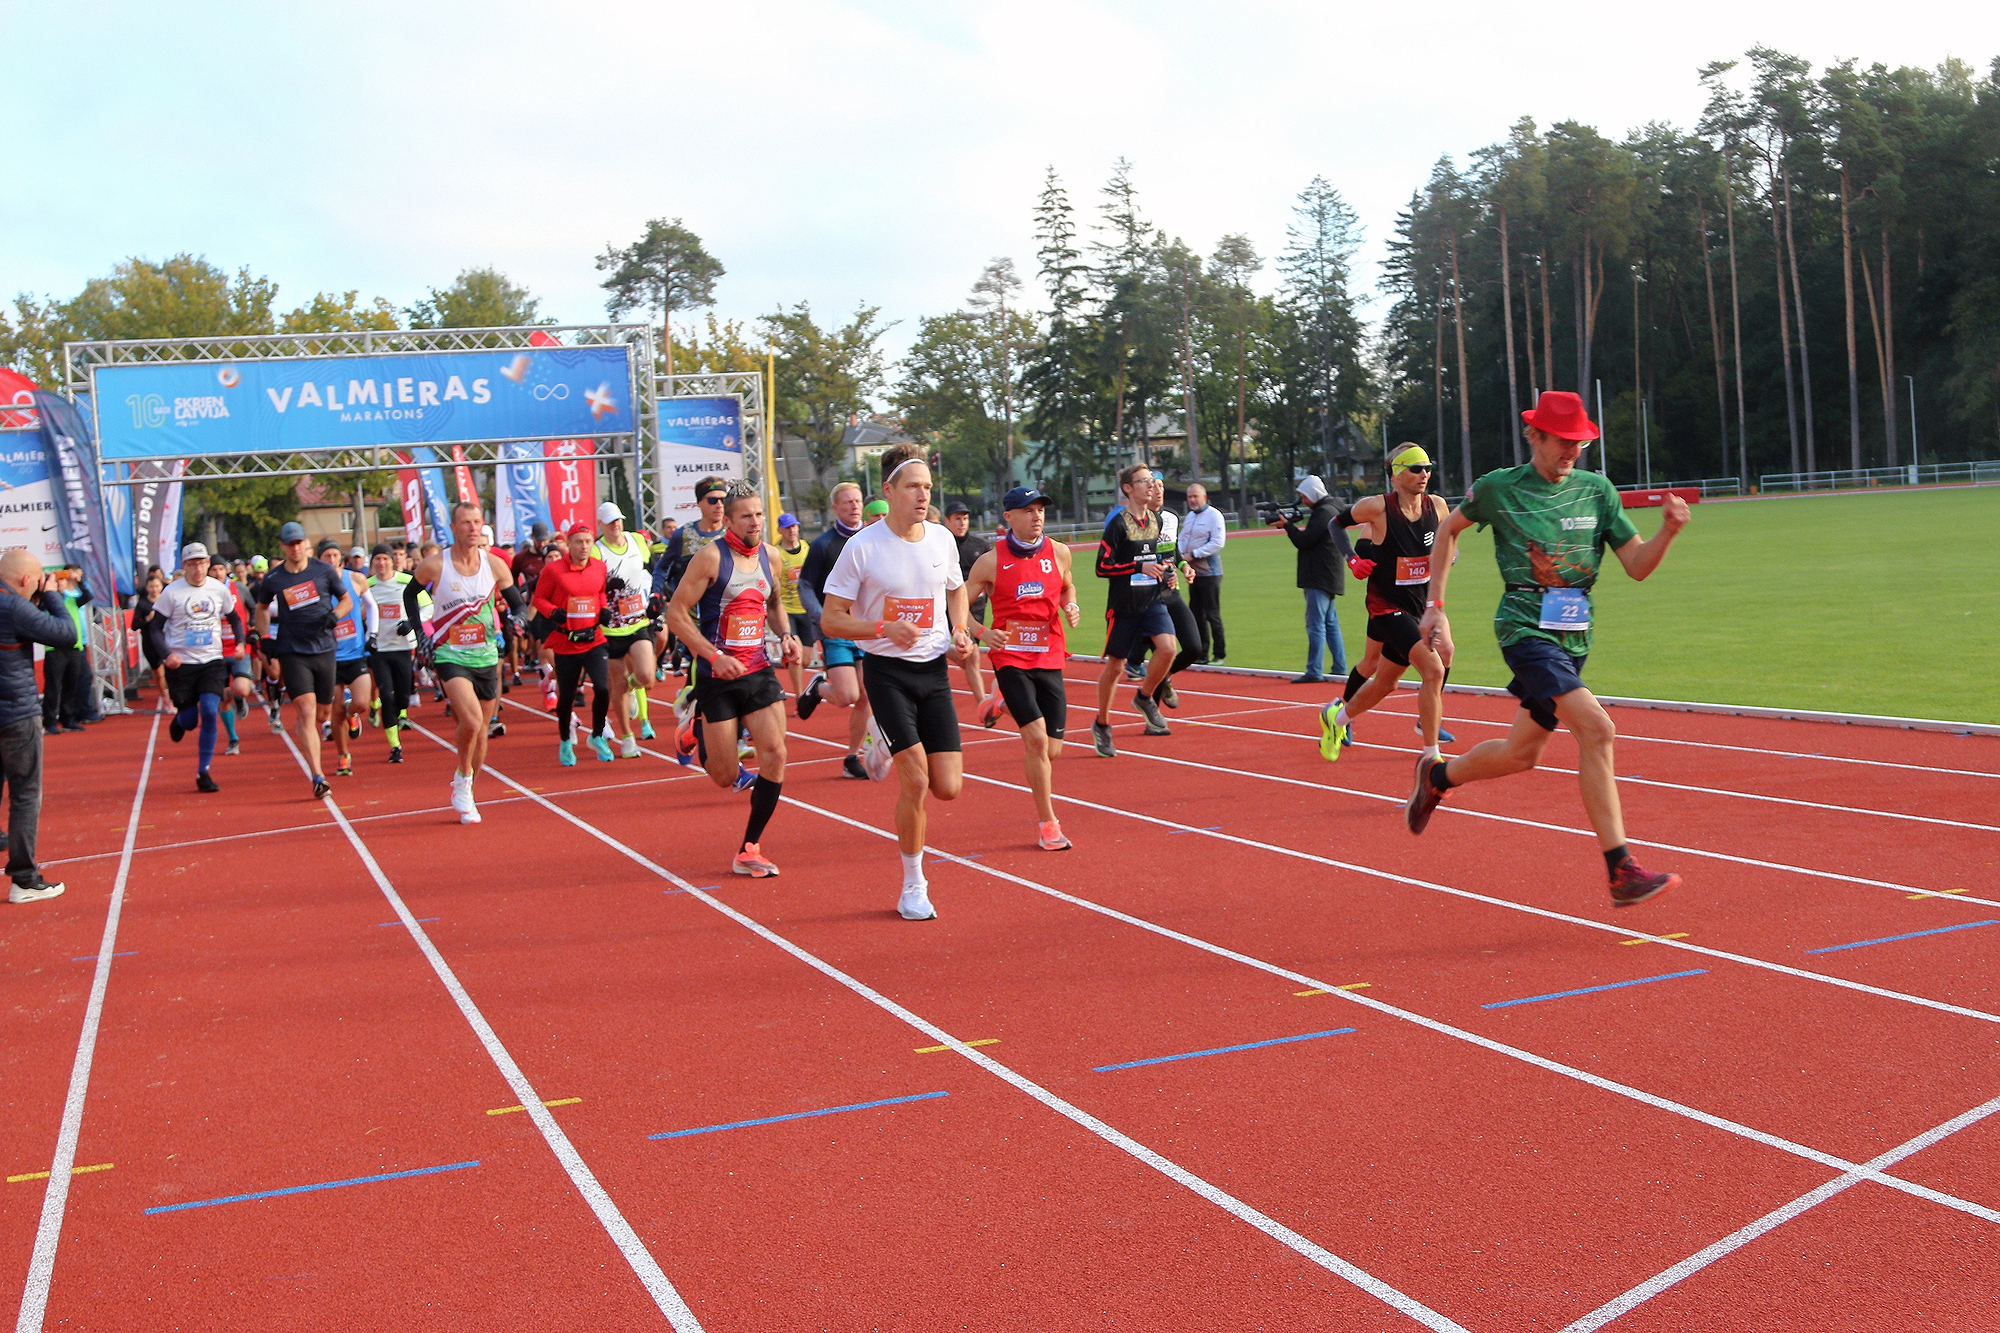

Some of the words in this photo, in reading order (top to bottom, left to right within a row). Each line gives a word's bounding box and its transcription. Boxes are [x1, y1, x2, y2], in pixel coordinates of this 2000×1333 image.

[267, 375, 492, 414] VALMIERAS
[174, 396, 224, 408] SKRIEN
[175, 405, 230, 419] LATVIJA
[340, 408, 424, 423] MARATONS
[667, 415, 734, 427] VALMIERAS
[674, 462, 730, 475] VALMIERA
[139, 496, 154, 524] DO
[1560, 517, 1574, 530] 10
[136, 524, 149, 566] JUST
[1409, 567, 1426, 576] 140
[897, 611, 923, 623] 287
[1561, 605, 1579, 617] 22
[739, 626, 757, 636] 202
[1019, 632, 1038, 642] 128
[459, 633, 478, 642] 204
